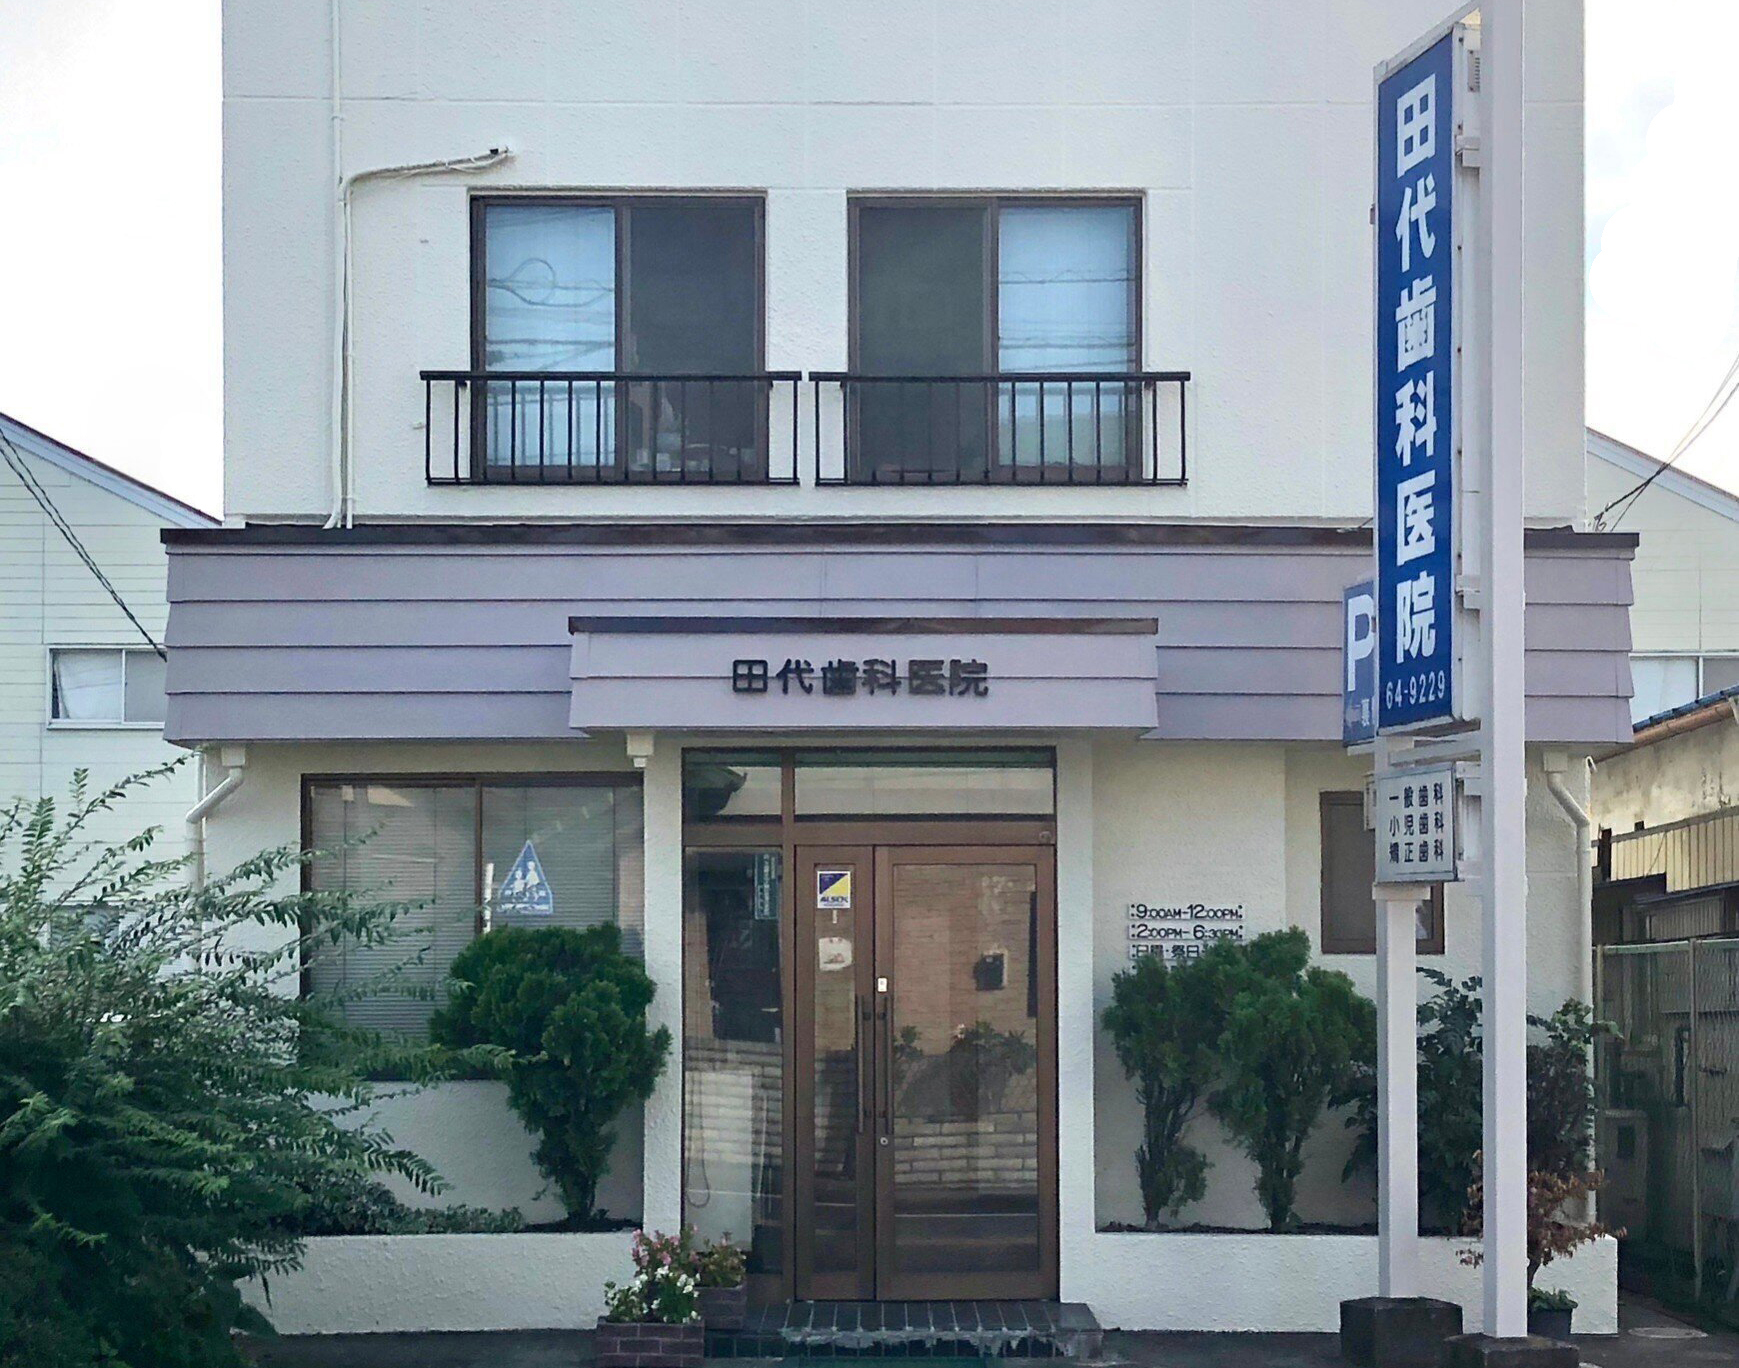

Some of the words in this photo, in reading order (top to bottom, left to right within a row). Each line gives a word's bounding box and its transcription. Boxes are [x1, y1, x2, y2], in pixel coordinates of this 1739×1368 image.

[1395, 73, 1437, 665] 田代歯科医院
[1347, 594, 1374, 692] P
[732, 658, 990, 696] 田代歯科医院
[1385, 670, 1446, 710] 64-9229
[1389, 782, 1443, 808] 一般歯科
[1389, 811, 1444, 837] 小児歯科
[1389, 839, 1444, 864] 矯正歯科
